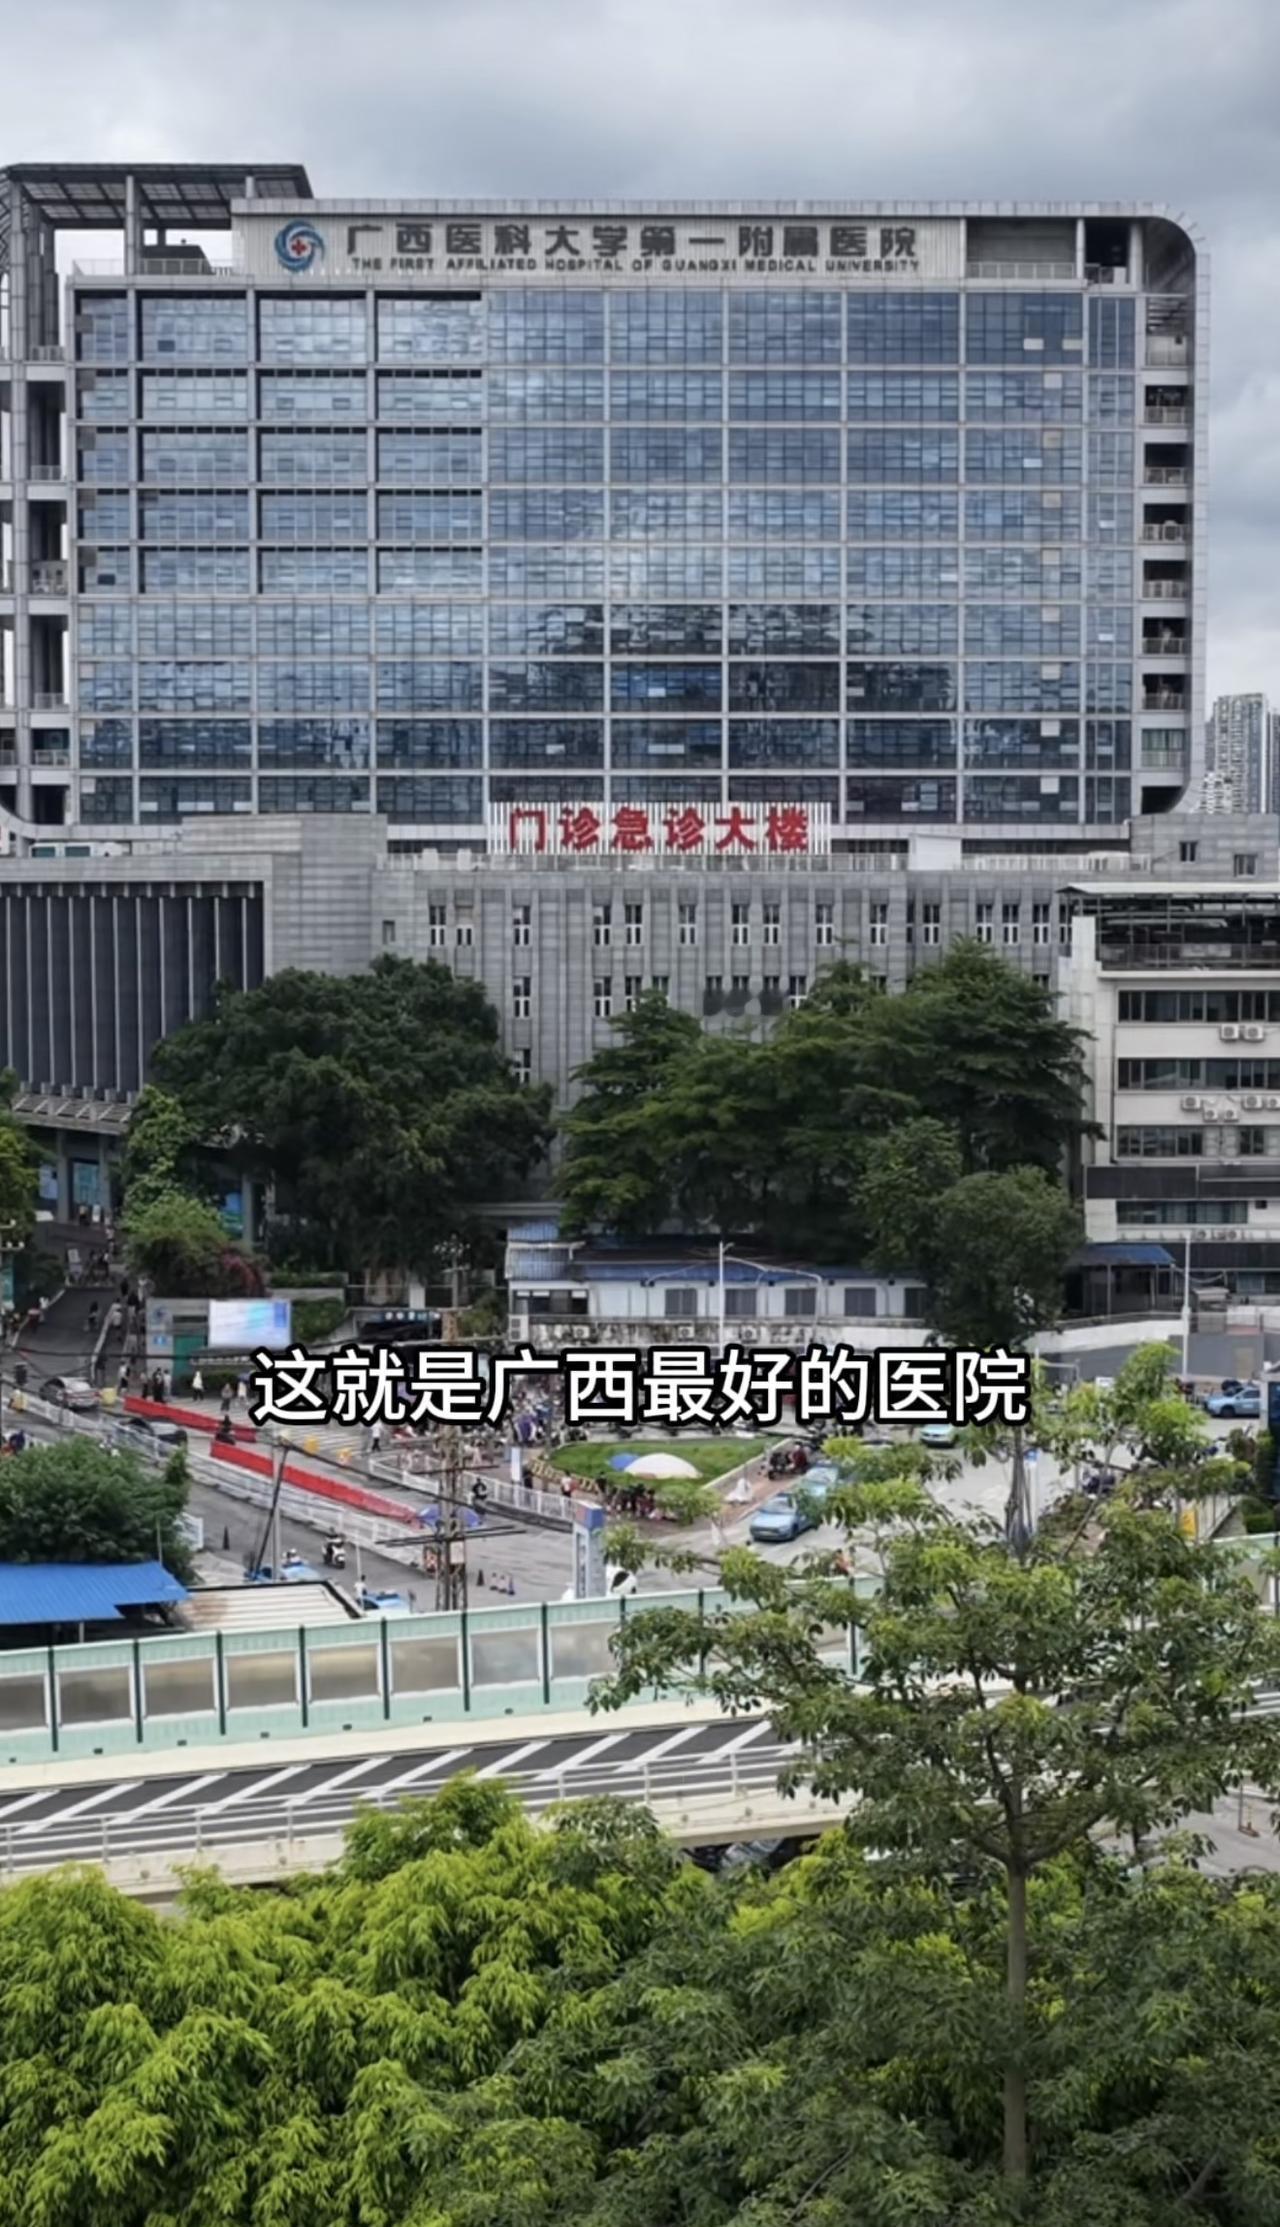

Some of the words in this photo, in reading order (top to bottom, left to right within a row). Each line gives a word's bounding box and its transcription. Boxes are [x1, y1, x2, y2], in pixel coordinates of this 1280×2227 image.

[352, 257, 382, 270] THE
[390, 257, 434, 270] FIRST
[446, 257, 537, 271] AFFILIATED
[545, 258, 623, 271] HOSPITAL
[632, 258, 653, 271] OF
[662, 259, 736, 271] GUANGXI
[745, 259, 816, 272] MEDICAL
[825, 259, 919, 272] UNIVERSITY
[509, 806, 808, 850] 门诊急诊大楼
